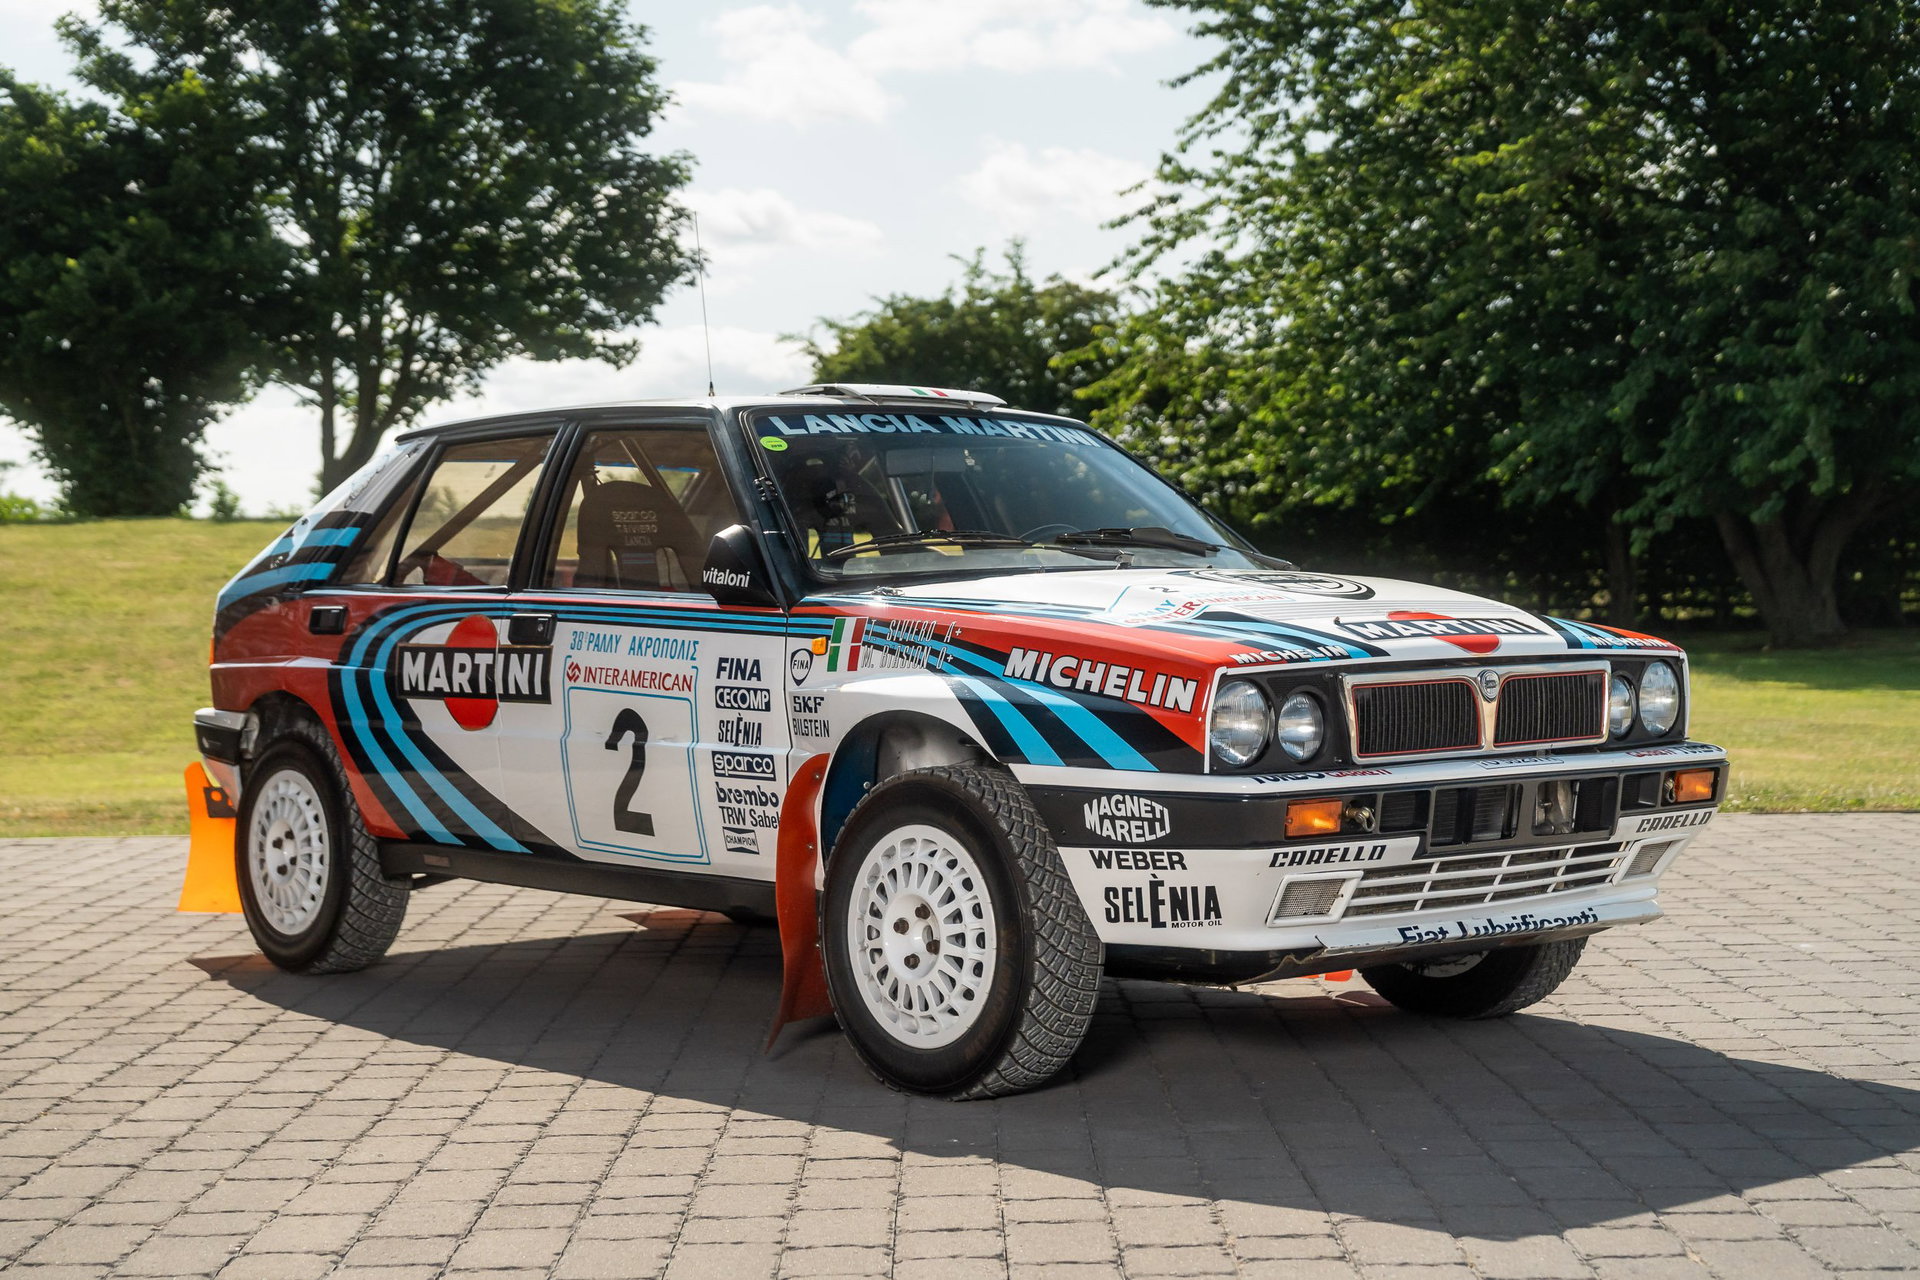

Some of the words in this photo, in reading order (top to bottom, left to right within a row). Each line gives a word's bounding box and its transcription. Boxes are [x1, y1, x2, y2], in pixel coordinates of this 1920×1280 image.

[768, 413, 941, 437] LANCIA
[939, 415, 1101, 448] MARTINI
[703, 567, 751, 588] vitaloni
[886, 619, 937, 642] SIVIERO
[1350, 618, 1535, 640] MARTINI
[1586, 635, 1668, 647] MICHELIN
[793, 659, 809, 670] FINA
[1229, 644, 1350, 665] MICHELIN
[402, 651, 544, 695] MARTINI
[583, 666, 693, 692] INTERAMERICAN
[716, 657, 762, 681] FINA
[1003, 646, 1199, 713] MICHELIN
[716, 688, 770, 710] CECOMP
[793, 695, 824, 714] SKF
[792, 717, 830, 738] BILSTEIN
[605, 708, 656, 837] 2
[714, 753, 774, 775] sparco
[715, 782, 779, 808] brembo
[719, 806, 746, 826] TRW
[1635, 810, 1713, 833] CARELLO
[725, 834, 757, 847] CHAMPION
[1089, 849, 1188, 870] WEBER
[1268, 844, 1387, 868] CARELLO
[1104, 873, 1223, 929] SELÈNIA
[1397, 925, 1449, 947] Fiat
[1456, 908, 1599, 940] Lubrificanti
